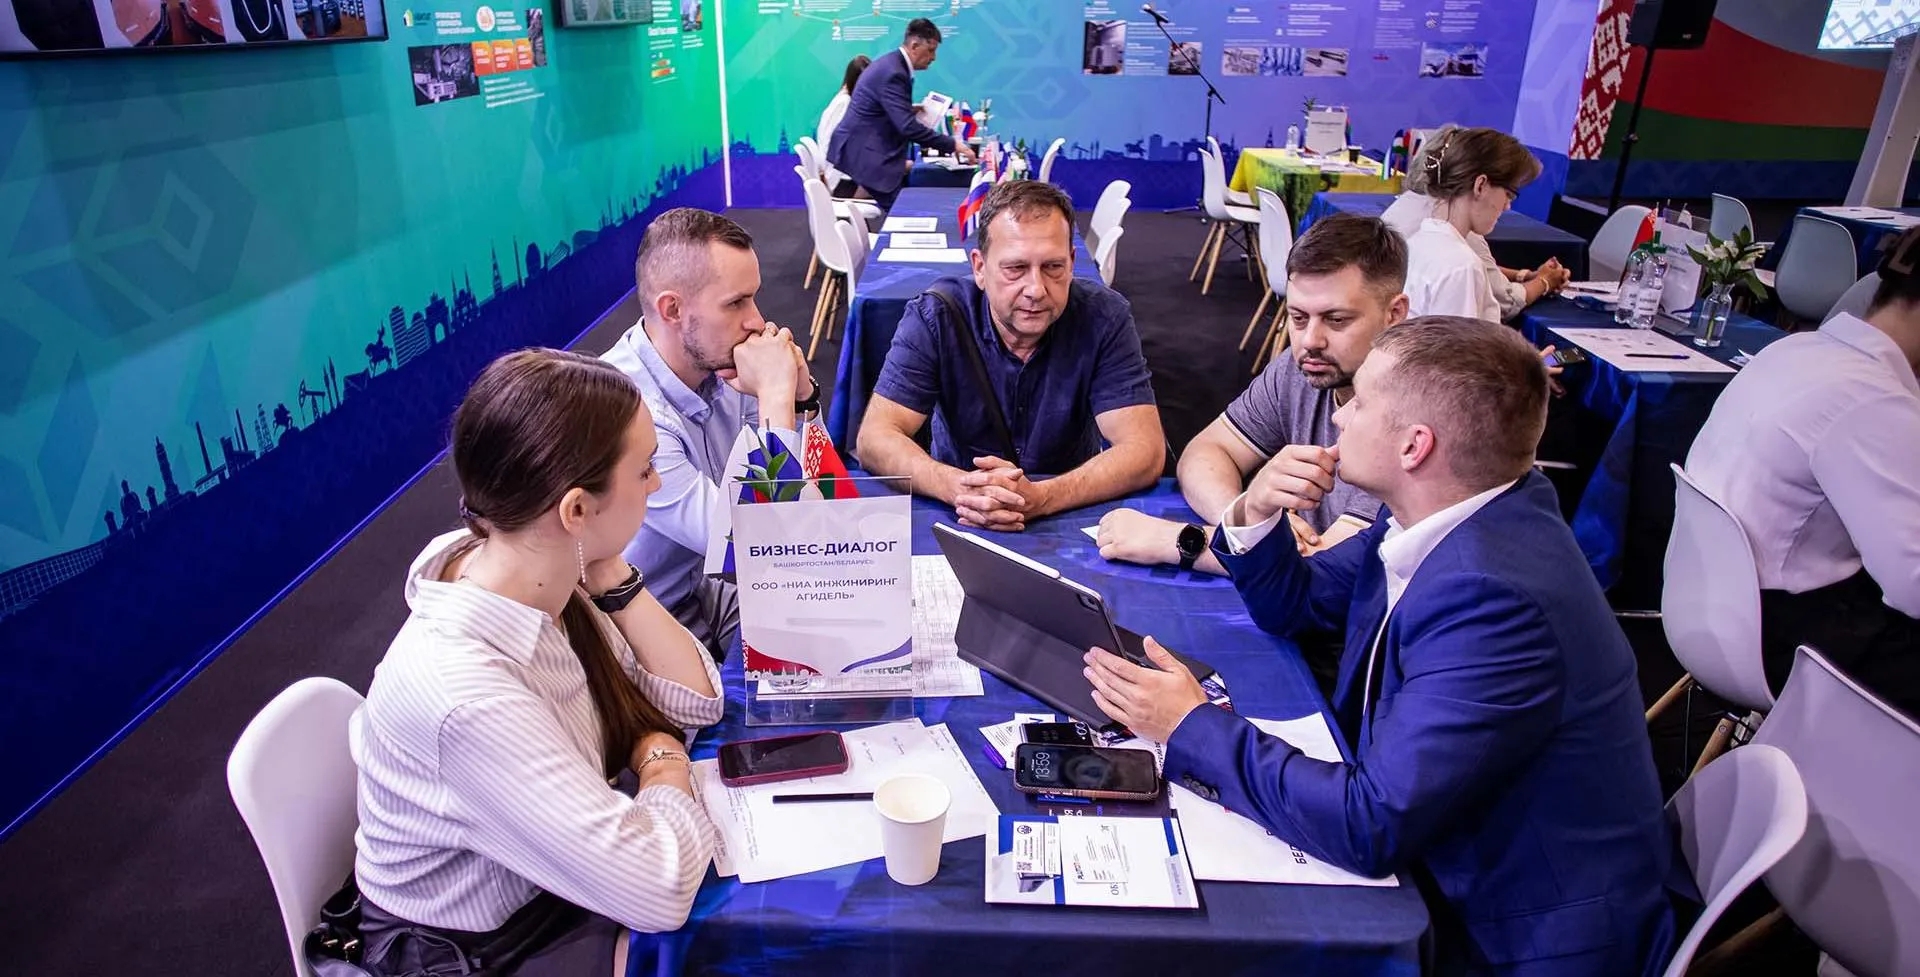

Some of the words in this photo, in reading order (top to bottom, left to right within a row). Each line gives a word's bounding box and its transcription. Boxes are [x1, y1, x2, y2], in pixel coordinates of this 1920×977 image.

[750, 541, 897, 557] БИЗНЕС-ДИАЛОГ
[752, 582, 778, 590] ООО
[781, 581, 812, 589] «НИА
[815, 578, 898, 588] ИНЖИНИРИНГ
[796, 592, 854, 601] АГИДЕЛЬ»
[1035, 752, 1050, 779] 13:59
